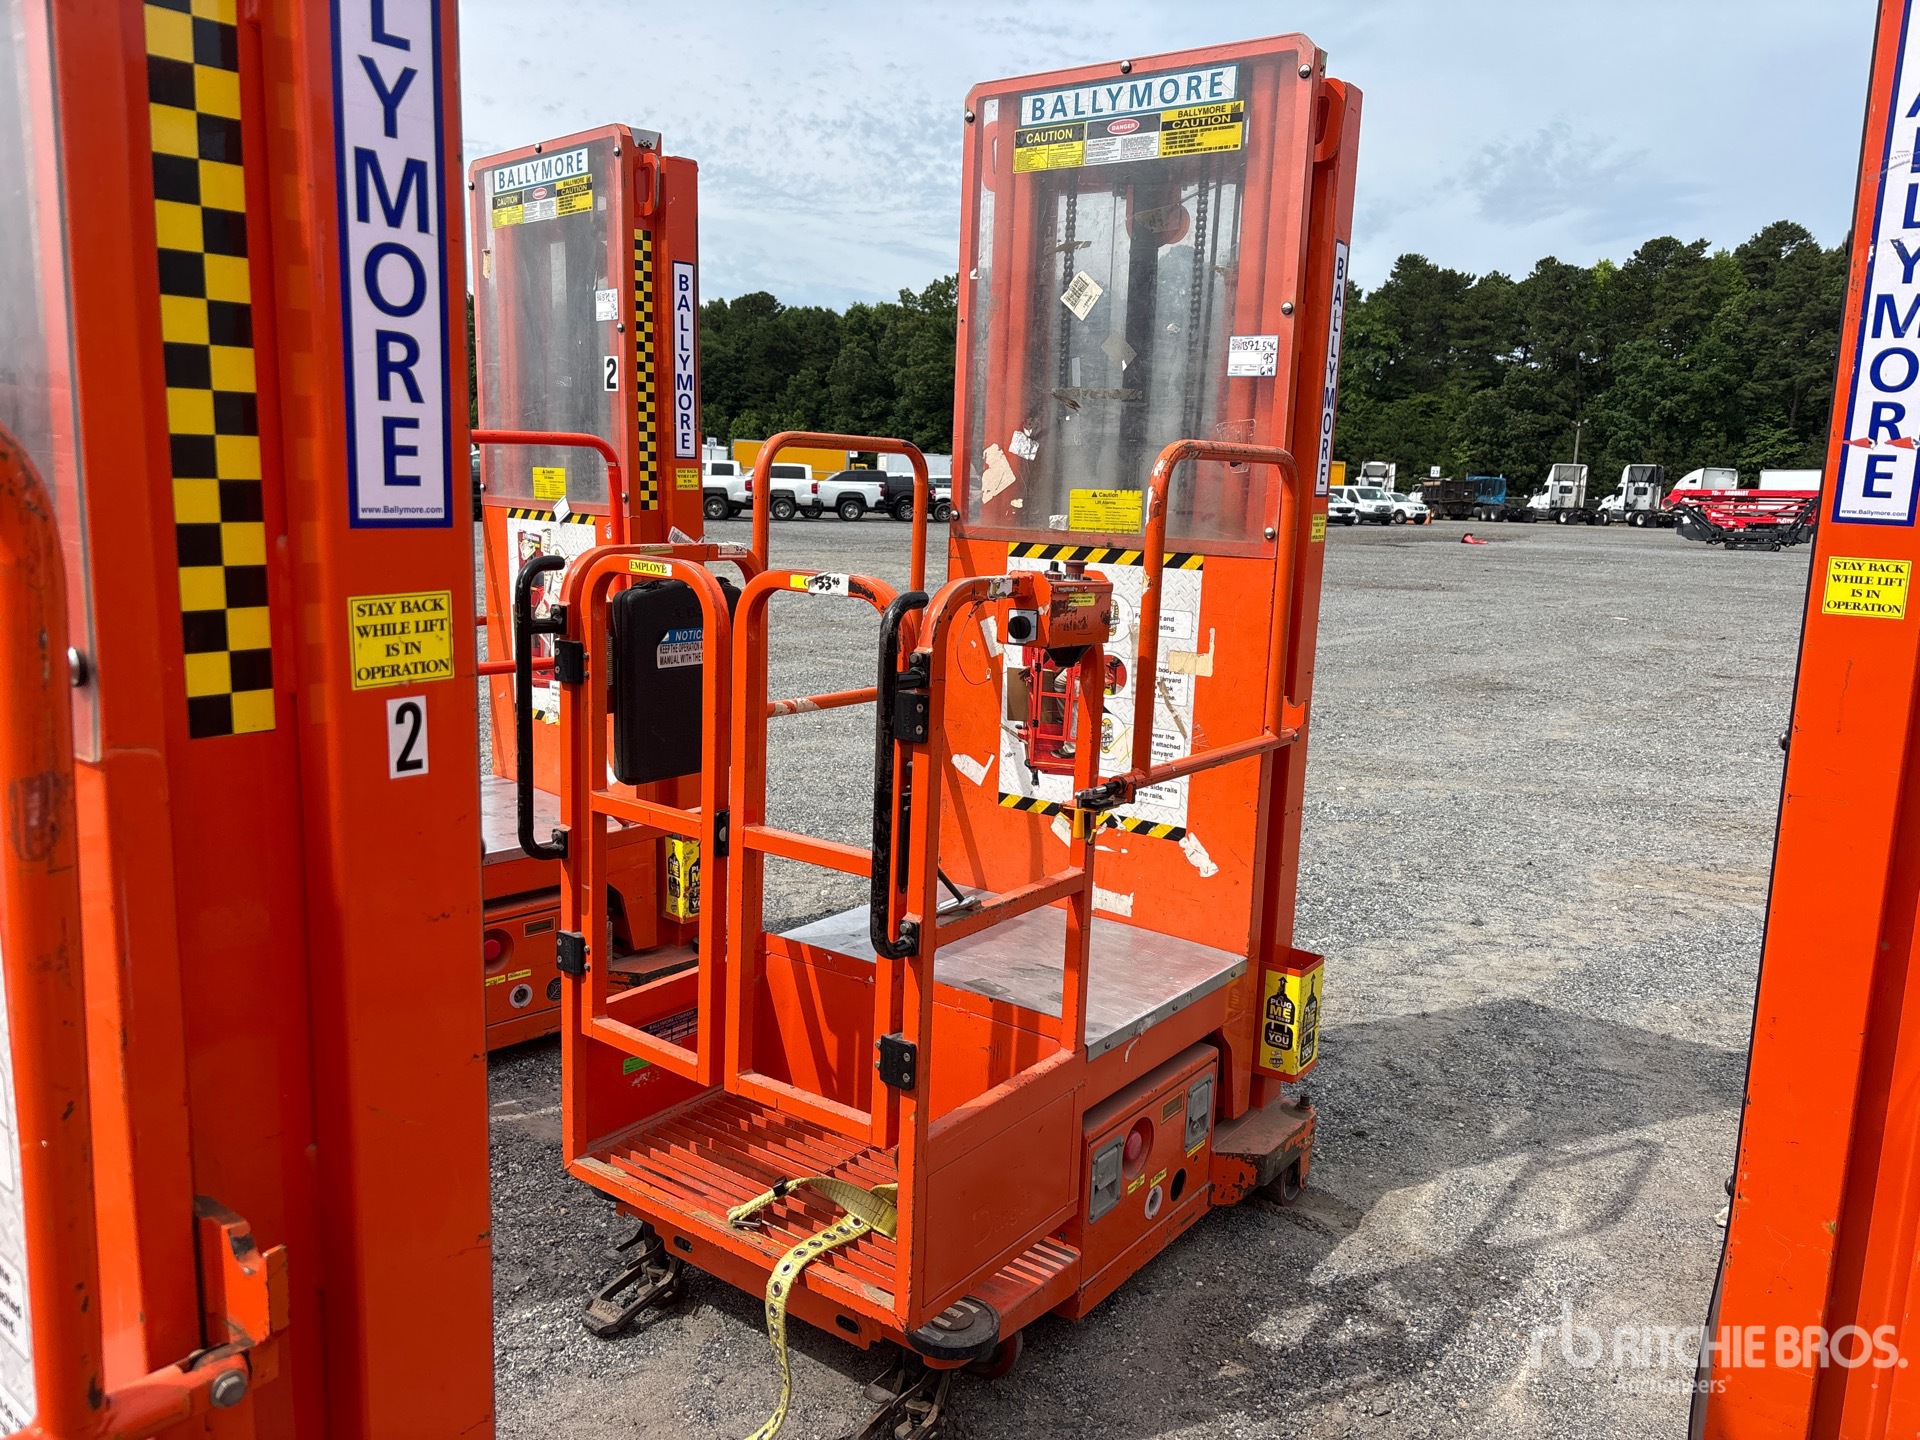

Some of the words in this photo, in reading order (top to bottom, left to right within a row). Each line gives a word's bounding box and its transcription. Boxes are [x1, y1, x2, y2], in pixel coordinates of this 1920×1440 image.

[1031, 71, 1224, 121] BALLYMORE
[1178, 105, 1226, 118] BALLYMORE
[1111, 122, 1135, 131] DANGER
[1172, 115, 1231, 129] CAUTION
[1026, 128, 1073, 144] CAUTION
[499, 152, 583, 189] BALLYMORE
[561, 185, 588, 195] CAUTION
[496, 195, 518, 206] CAUTION
[677, 273, 693, 450] BALLYMORE
[606, 358, 617, 389] 2
[1319, 257, 1344, 485] BALLYMORE
[361, 505, 443, 515] www.Ballymore.com
[1841, 509, 1906, 517] www.Ballymore.com
[1834, 561, 1865, 571] STAY
[1868, 563, 1905, 573] BACK
[1832, 574, 1873, 585] WHILE
[1878, 576, 1905, 587] LIFT
[1850, 588, 1862, 597] IS
[1866, 590, 1881, 599] IN
[356, 601, 396, 617] STAY
[401, 598, 445, 615] BACK
[1827, 600, 1902, 614] OPERATION
[356, 621, 411, 638] WHILE
[414, 618, 448, 634] LIFT
[676, 629, 702, 642] NOTIC
[385, 643, 400, 657] IS
[404, 641, 421, 655] IN
[679, 642, 699, 652] OPERATION
[660, 655, 680, 665] MANUAL
[680, 654, 691, 664] WITH
[692, 652, 701, 662] THE
[357, 657, 450, 682] OPERATION
[395, 701, 423, 773] 2
[1165, 733, 1175, 741] the
[1155, 742, 1180, 751] attached
[1138, 790, 1148, 798] the
[1149, 792, 1164, 800] rails.
[1164, 786, 1177, 794] rails
[1270, 998, 1292, 1009] PLUG
[1269, 1004, 1291, 1019] ME
[1268, 1032, 1289, 1045] YOU
